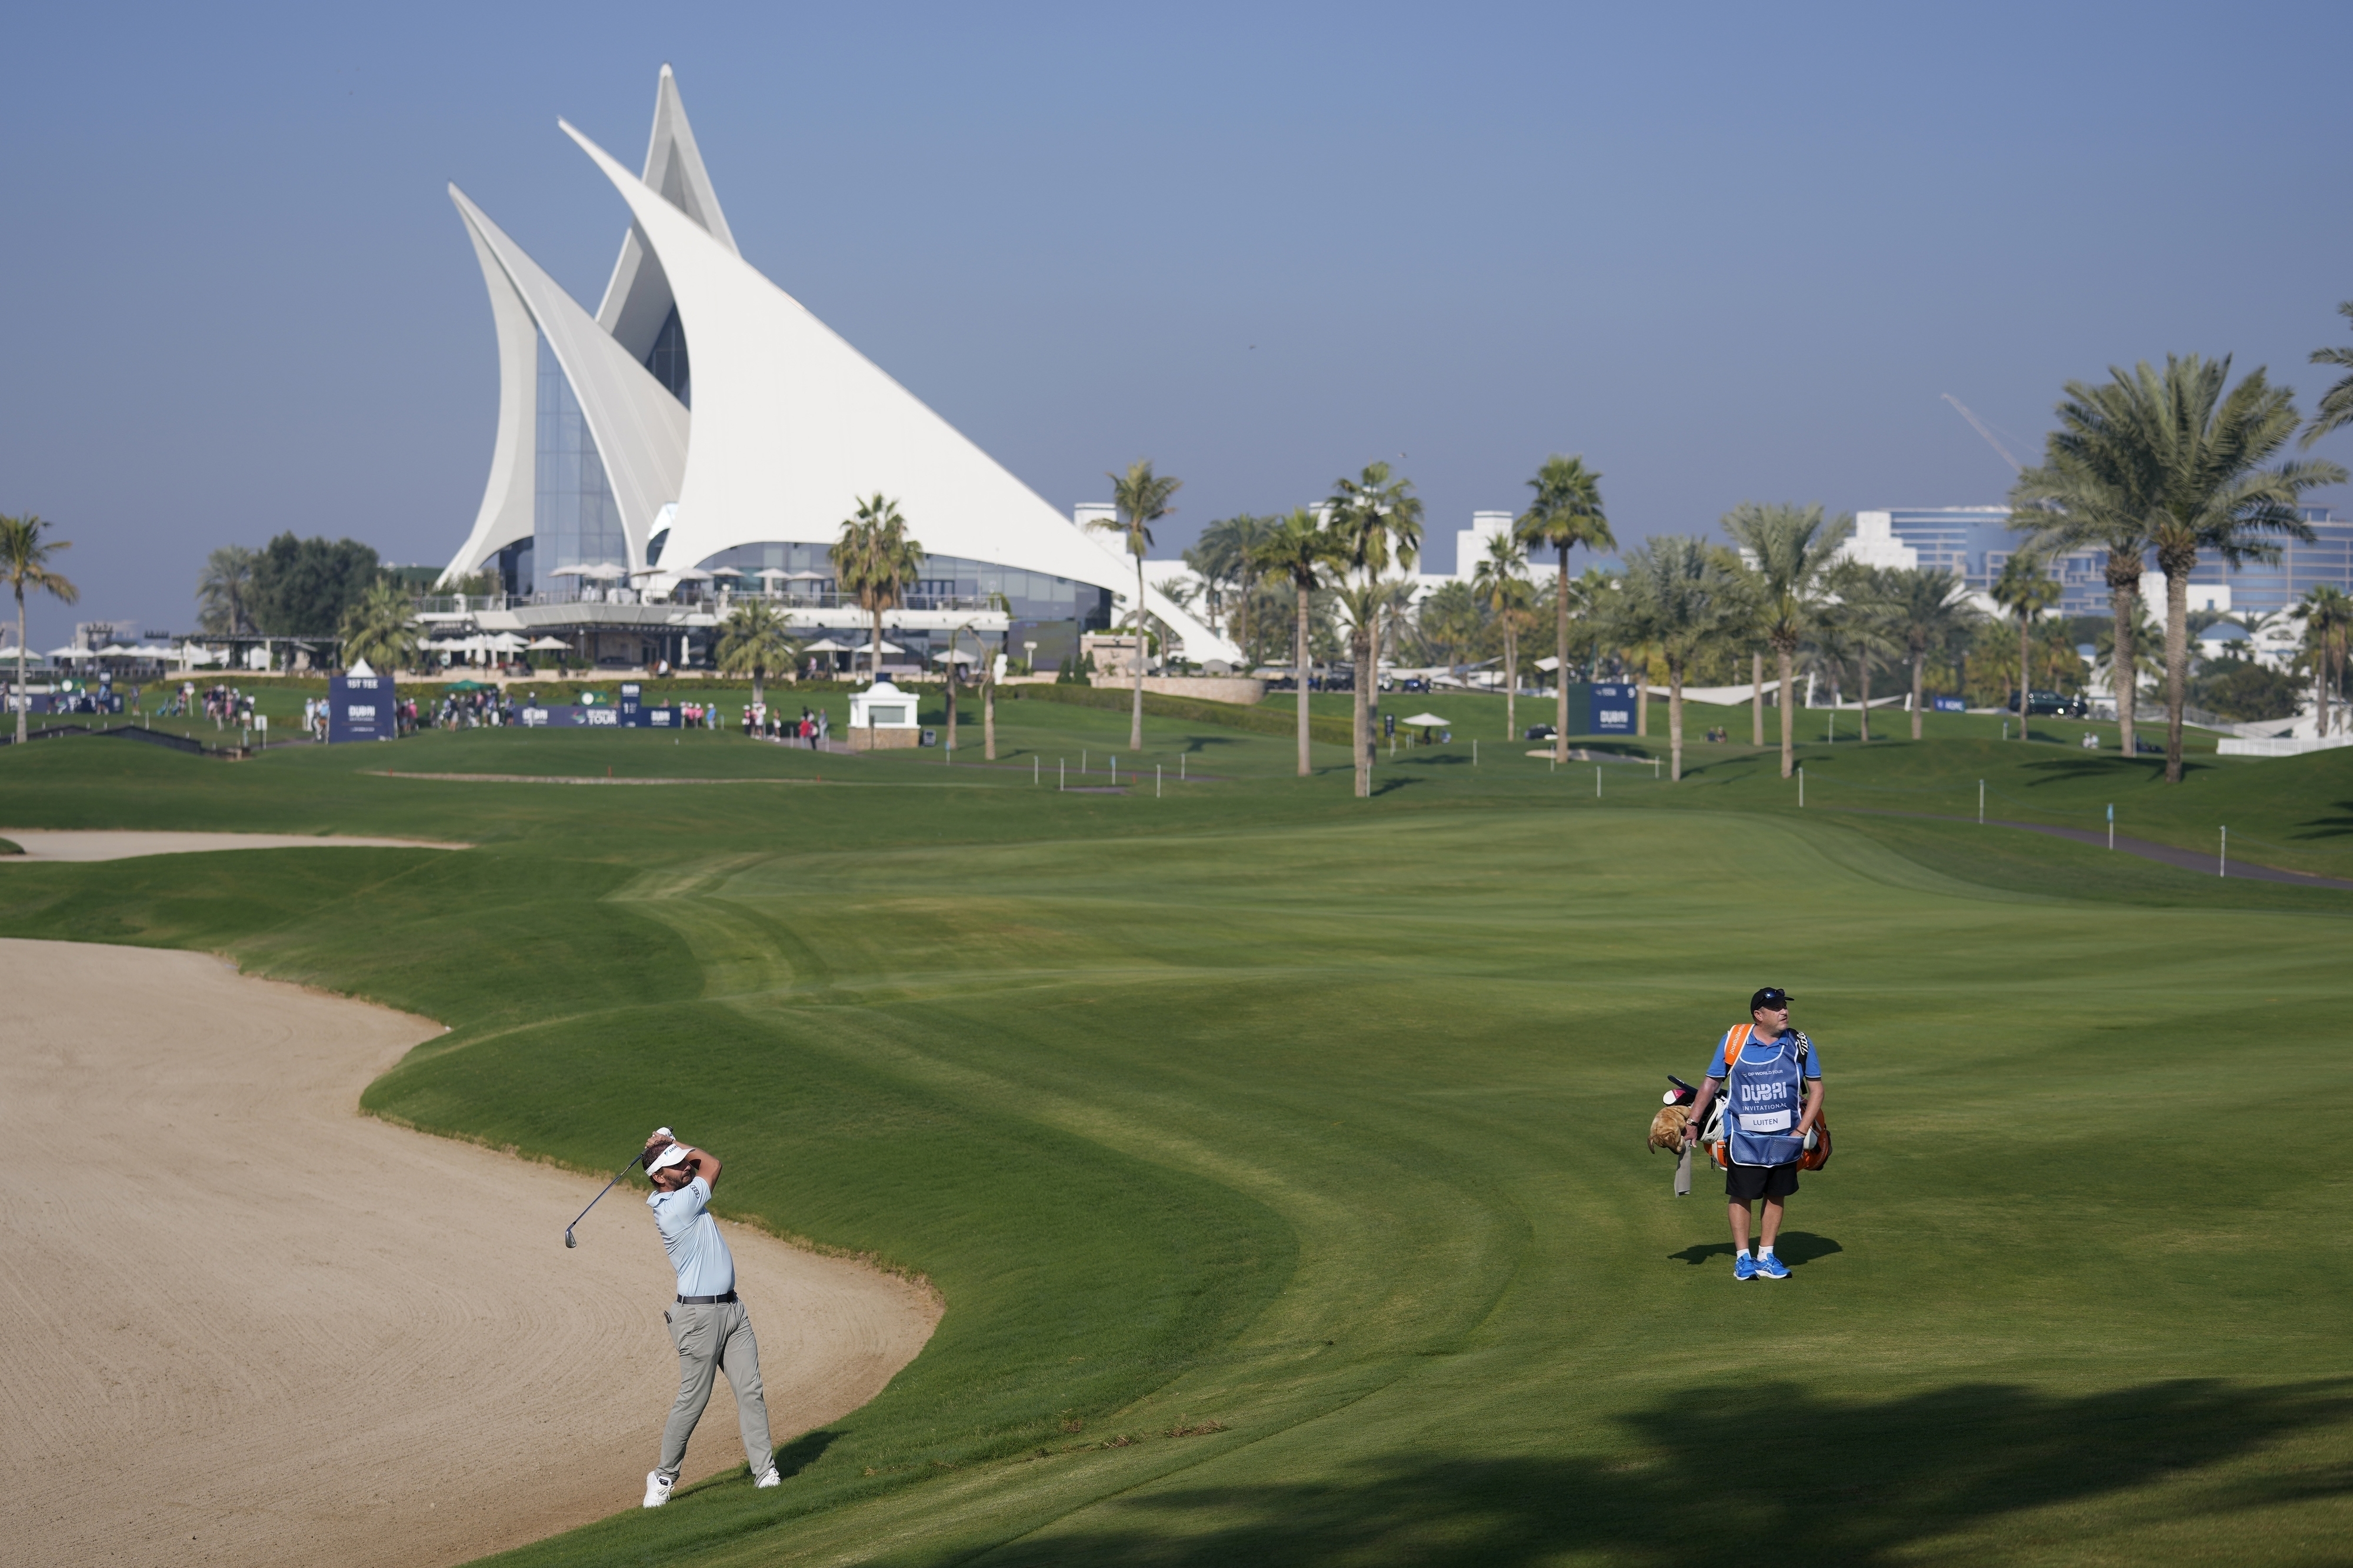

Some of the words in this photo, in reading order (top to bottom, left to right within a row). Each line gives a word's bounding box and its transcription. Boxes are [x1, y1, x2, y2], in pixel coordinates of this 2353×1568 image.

[362, 679, 378, 689] TEE
[348, 705, 375, 717] DUBAI
[1600, 710, 1628, 723] DUBAI
[588, 715, 617, 725] TOUR
[1741, 1082, 1787, 1103] DUBAI
[1742, 1103, 1787, 1111] INVITATIONAL
